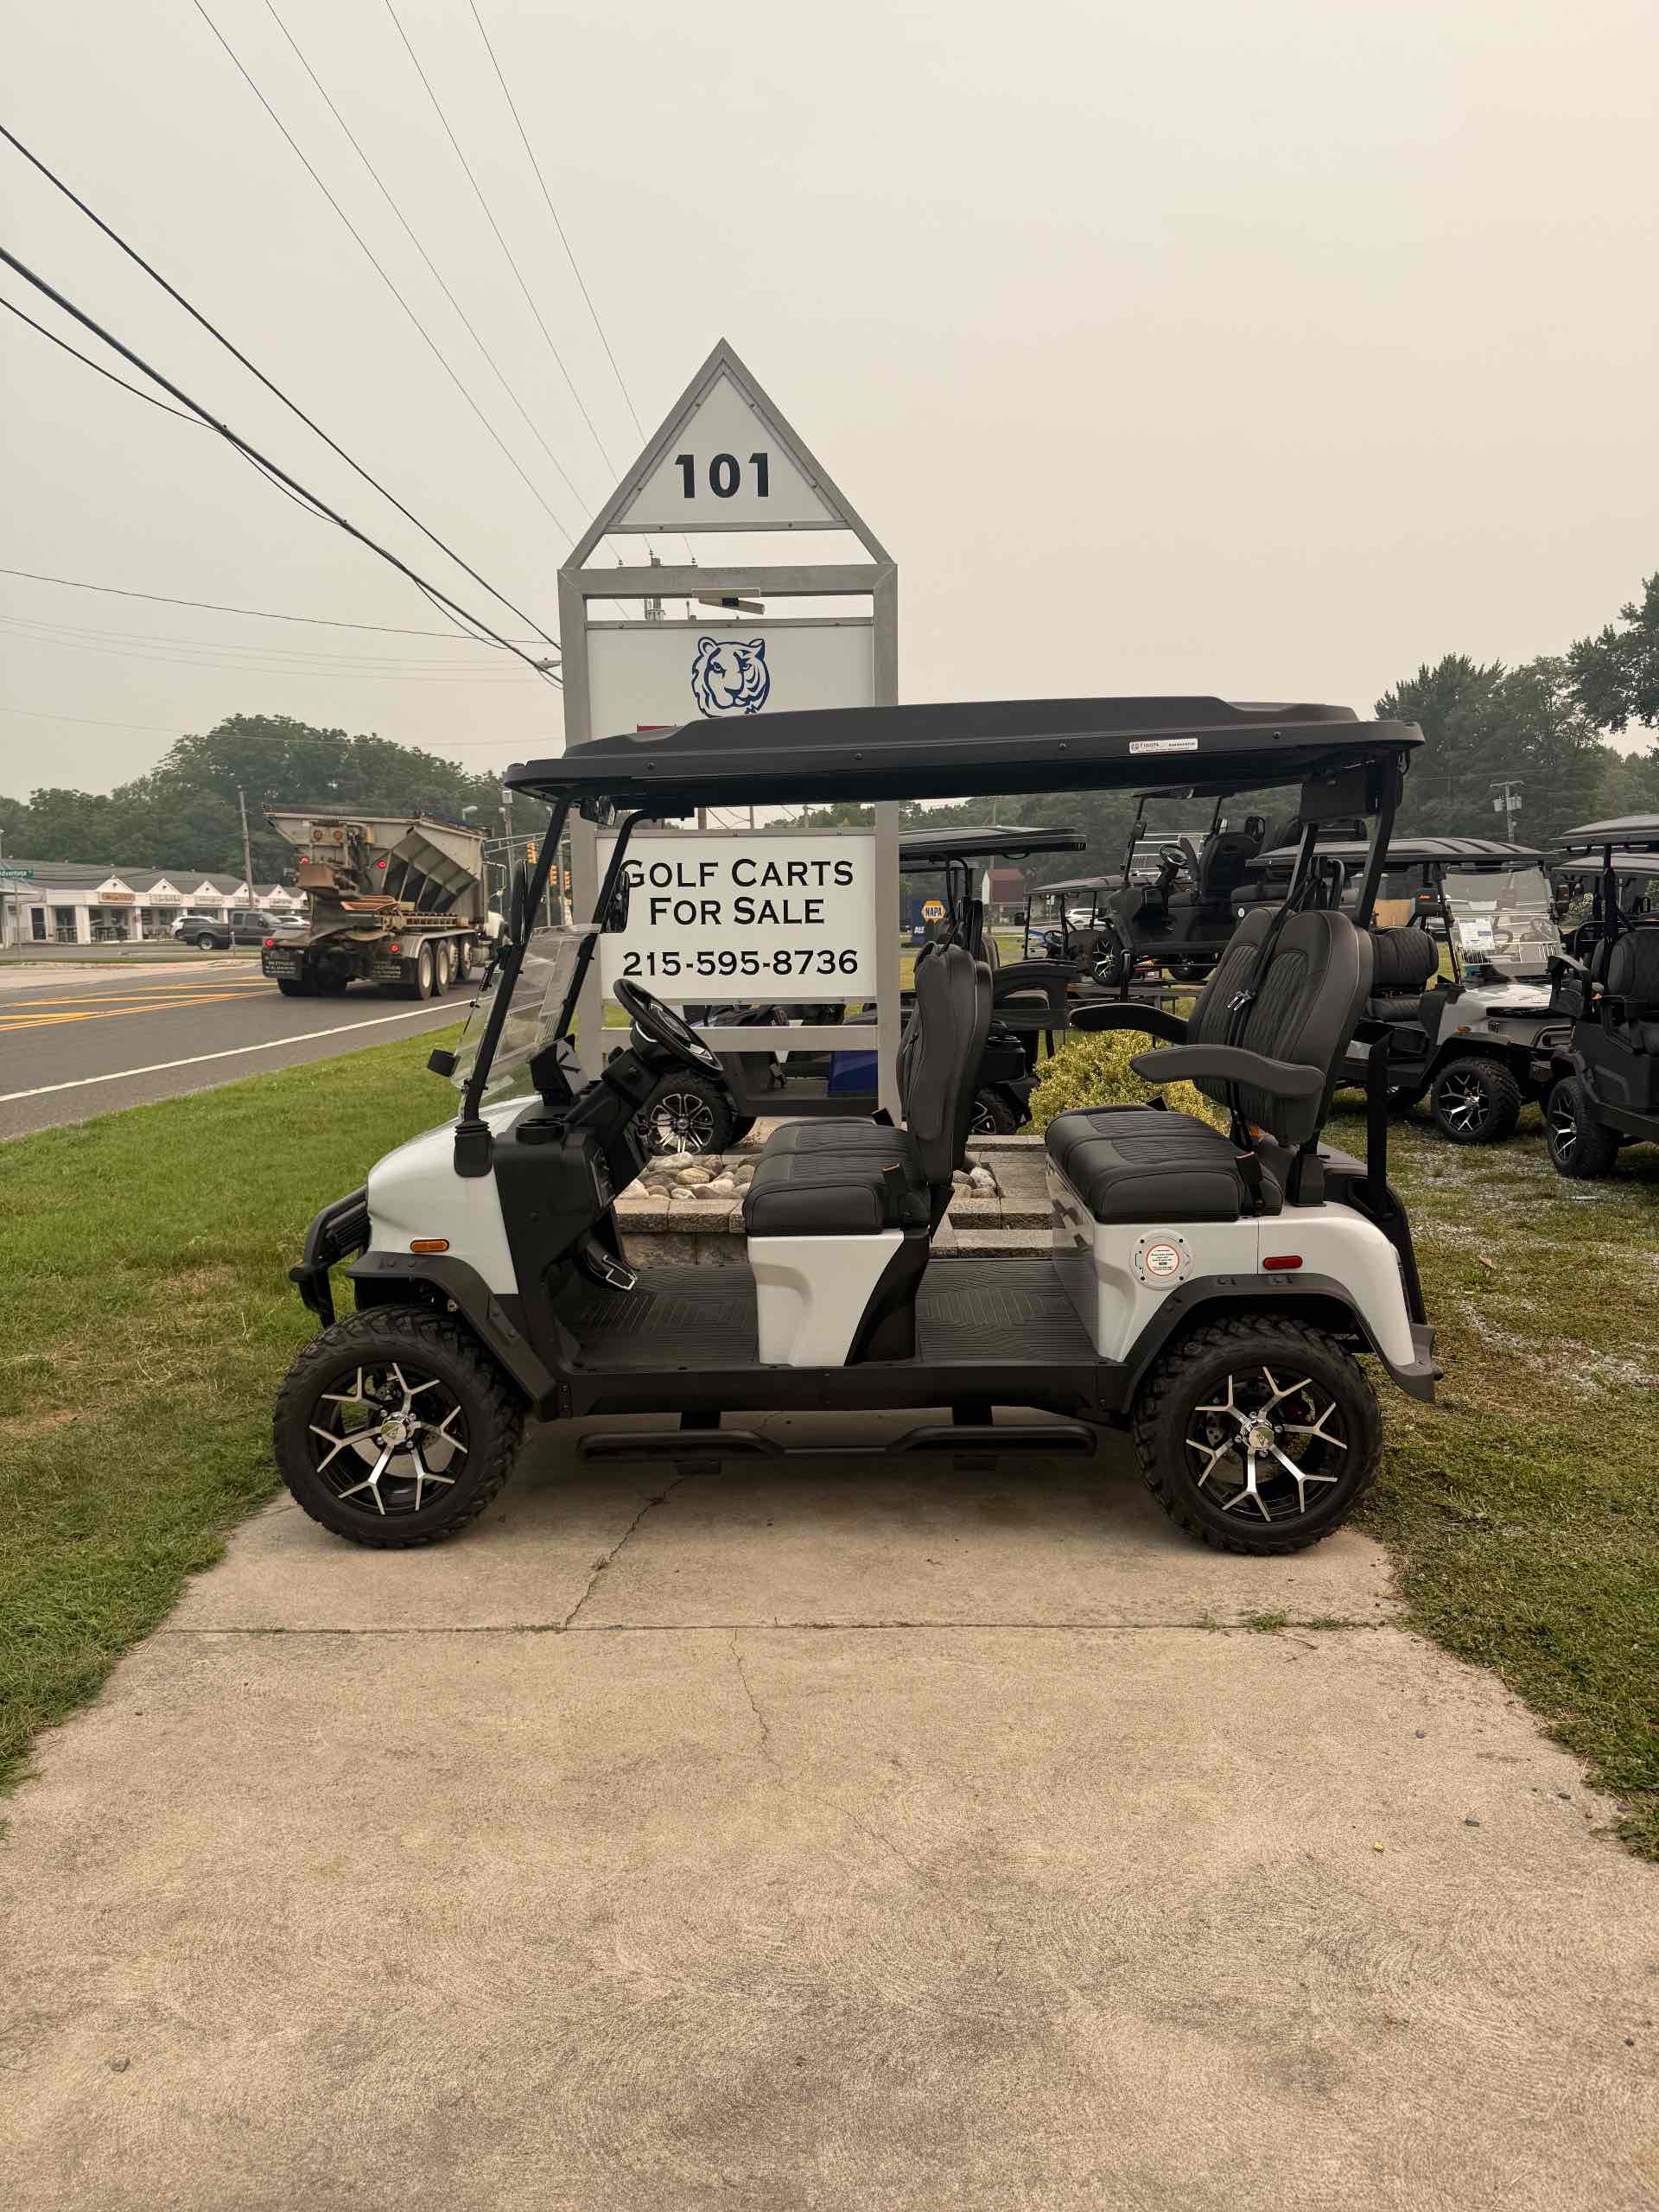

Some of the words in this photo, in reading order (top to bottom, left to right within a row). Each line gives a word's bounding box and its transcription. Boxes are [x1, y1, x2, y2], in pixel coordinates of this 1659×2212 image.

[674, 452, 770, 499] 101
[620, 859, 719, 888] GOLF
[732, 858, 854, 887] CARTS
[650, 897, 722, 925] FOR
[734, 896, 824, 925] SALE
[926, 906, 941, 918] NAPA
[622, 950, 858, 976] 215-595-8736
